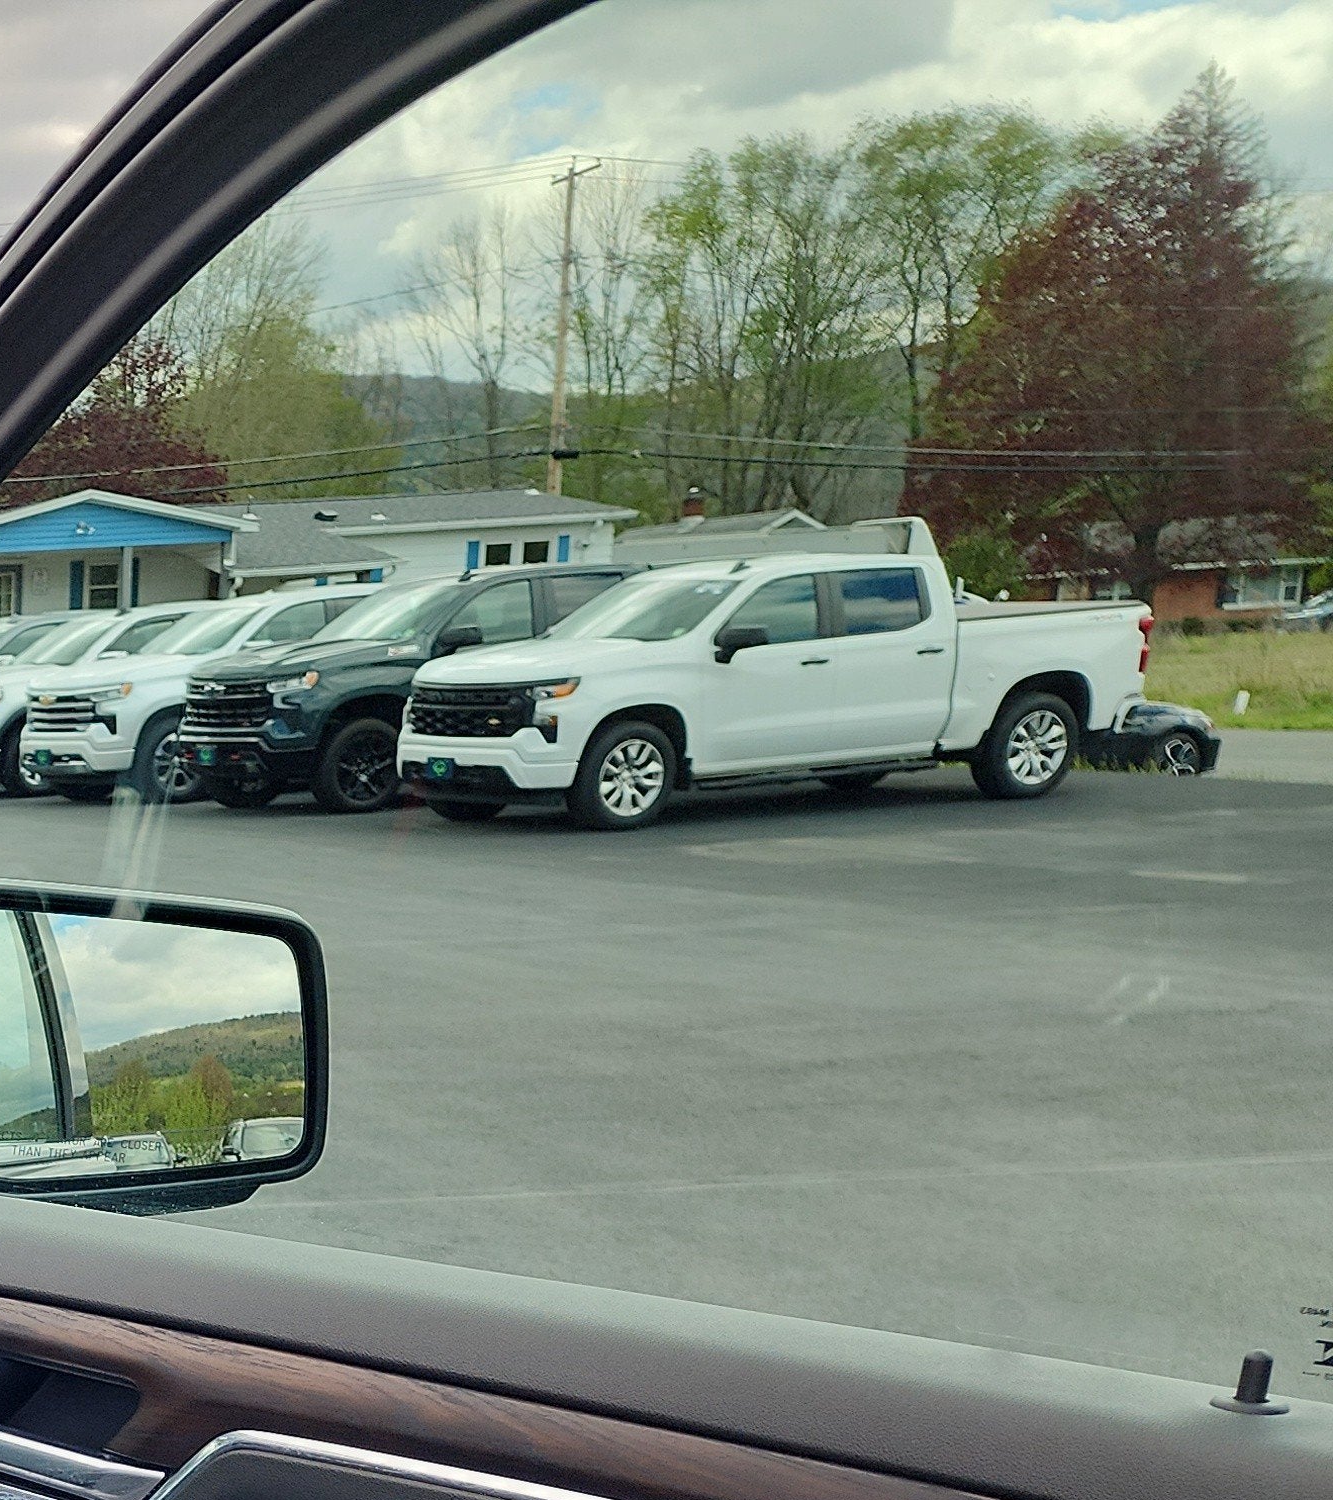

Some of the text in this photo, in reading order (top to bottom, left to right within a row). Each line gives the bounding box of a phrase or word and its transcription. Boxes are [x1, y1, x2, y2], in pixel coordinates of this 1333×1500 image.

[12, 1144, 41, 1157] THAN
[49, 1147, 77, 1160] THEY
[120, 1139, 162, 1152] CLOSER
